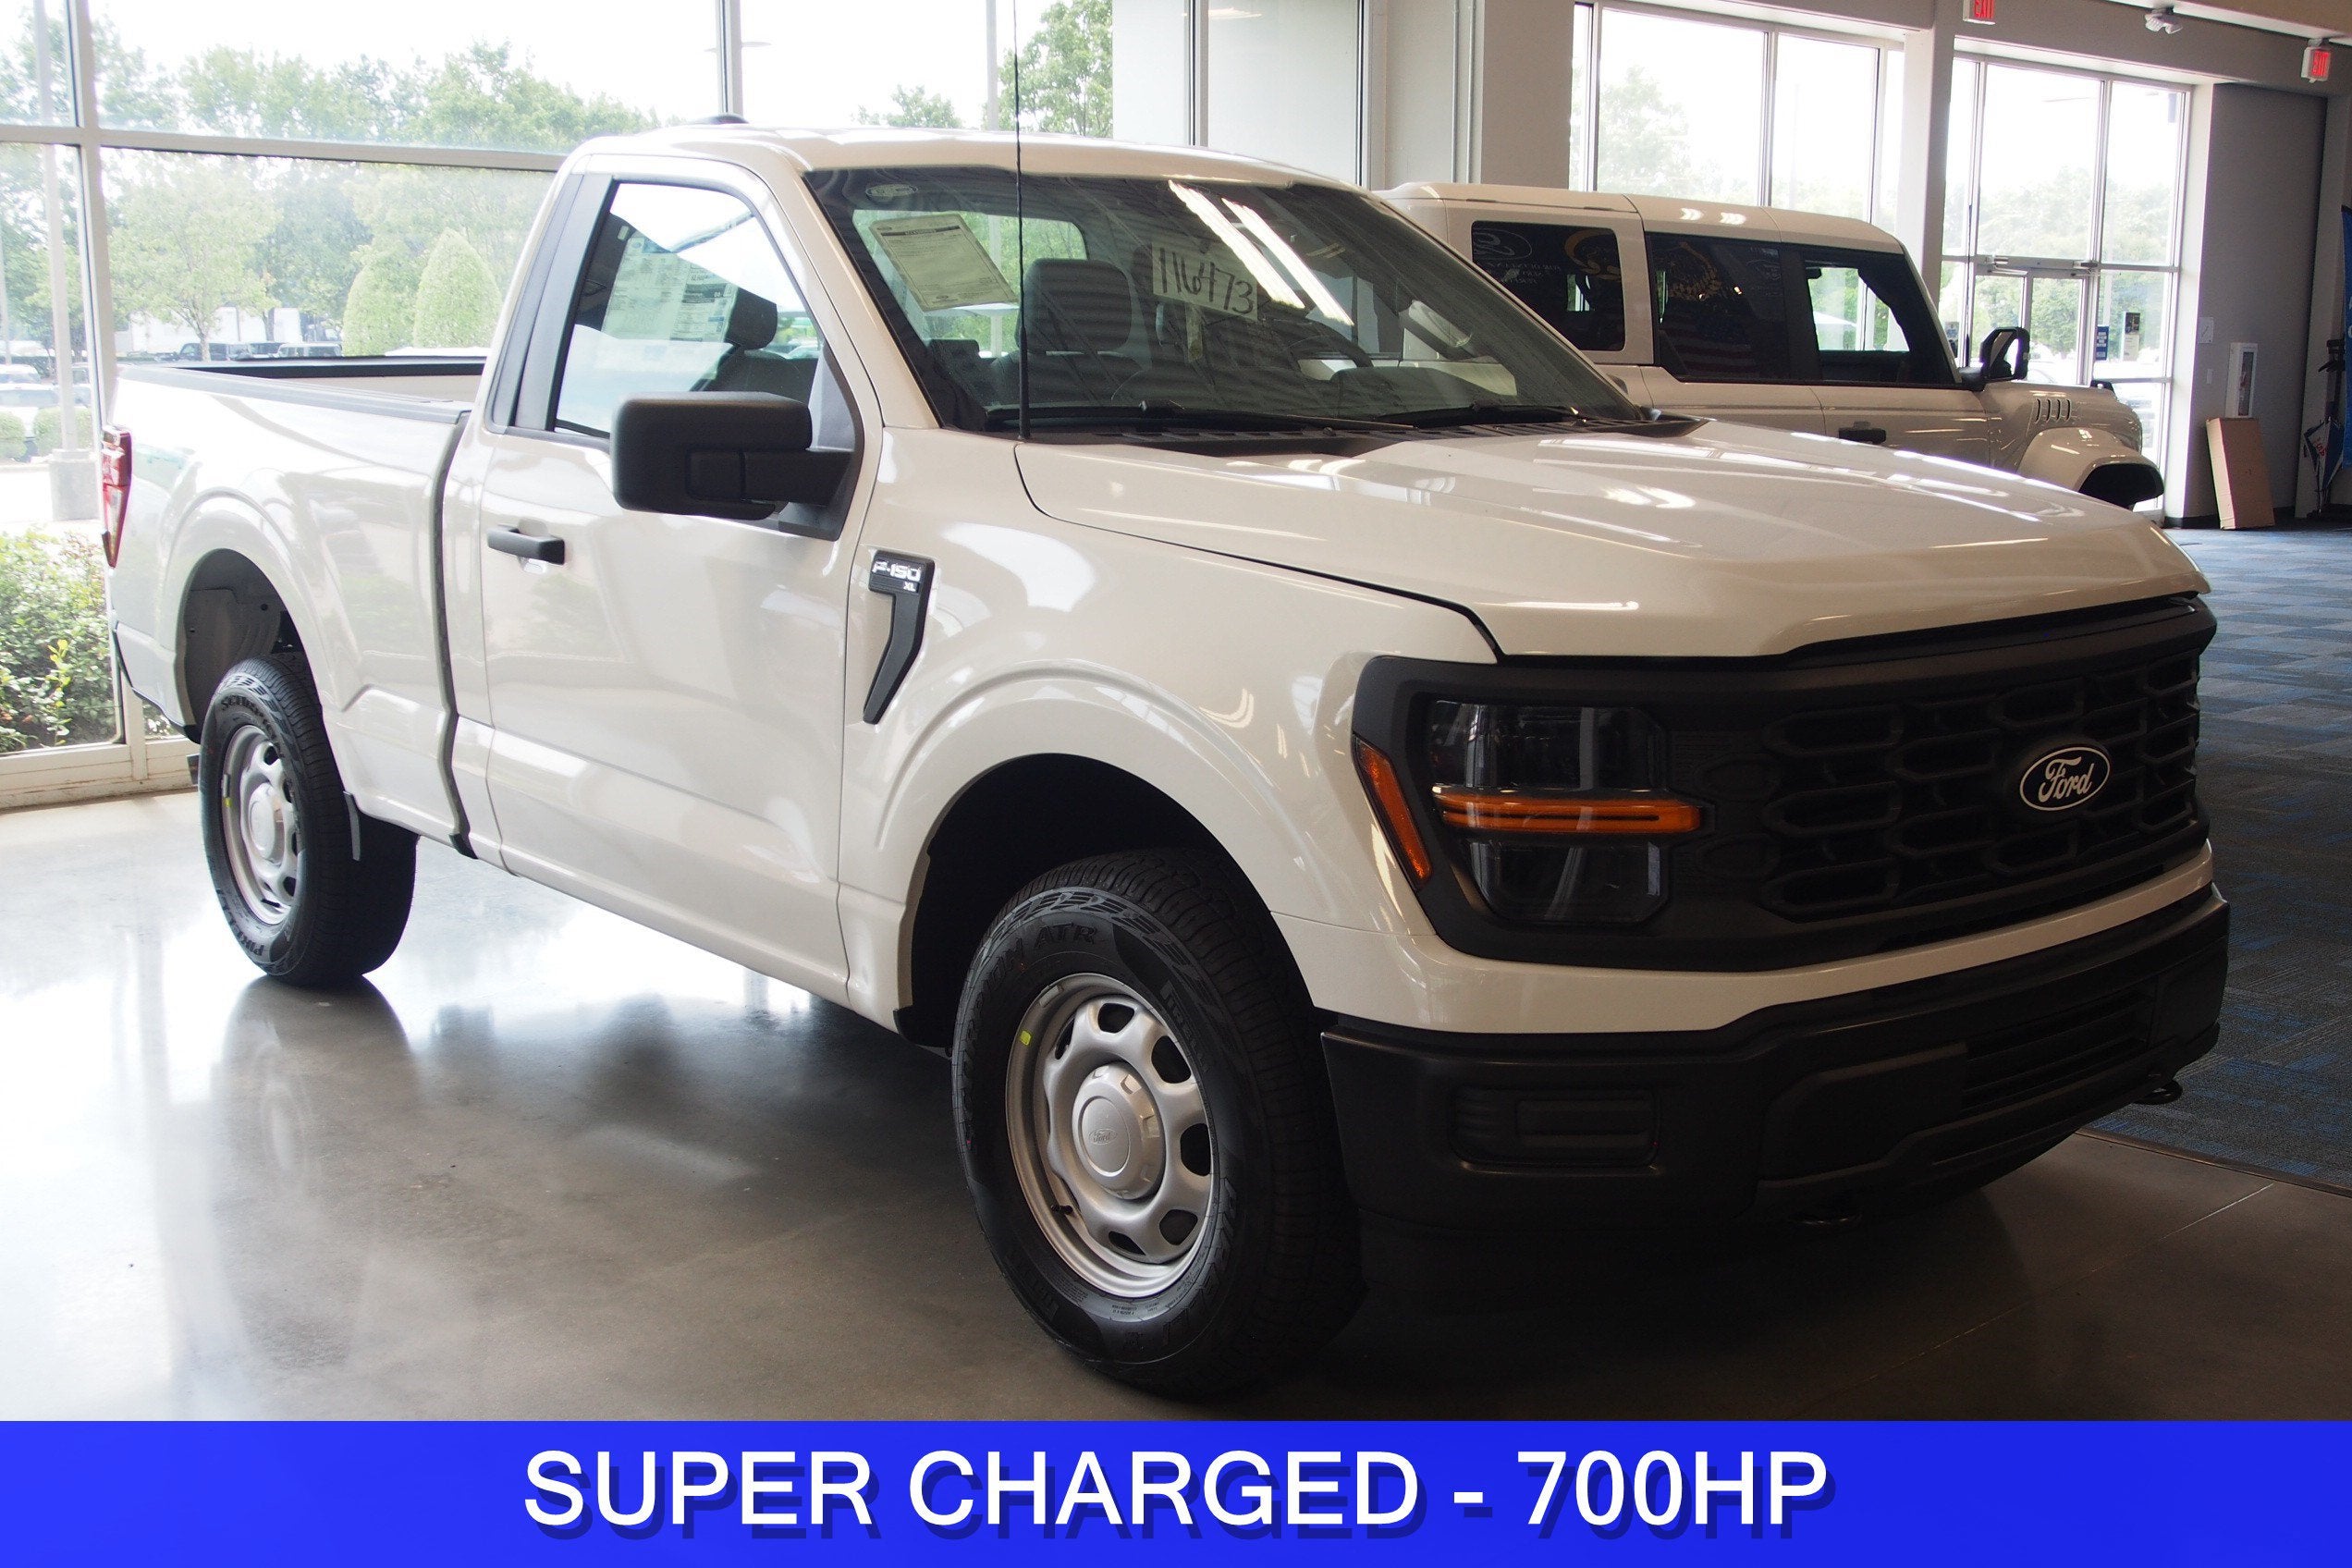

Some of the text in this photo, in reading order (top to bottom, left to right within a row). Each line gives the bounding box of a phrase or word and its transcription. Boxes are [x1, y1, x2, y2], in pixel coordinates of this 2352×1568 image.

[1159, 247, 1254, 314] 116473
[872, 560, 922, 582] F-150
[903, 582, 916, 592] XL
[2038, 756, 2095, 802] Ford
[1034, 923, 1098, 952] ATR
